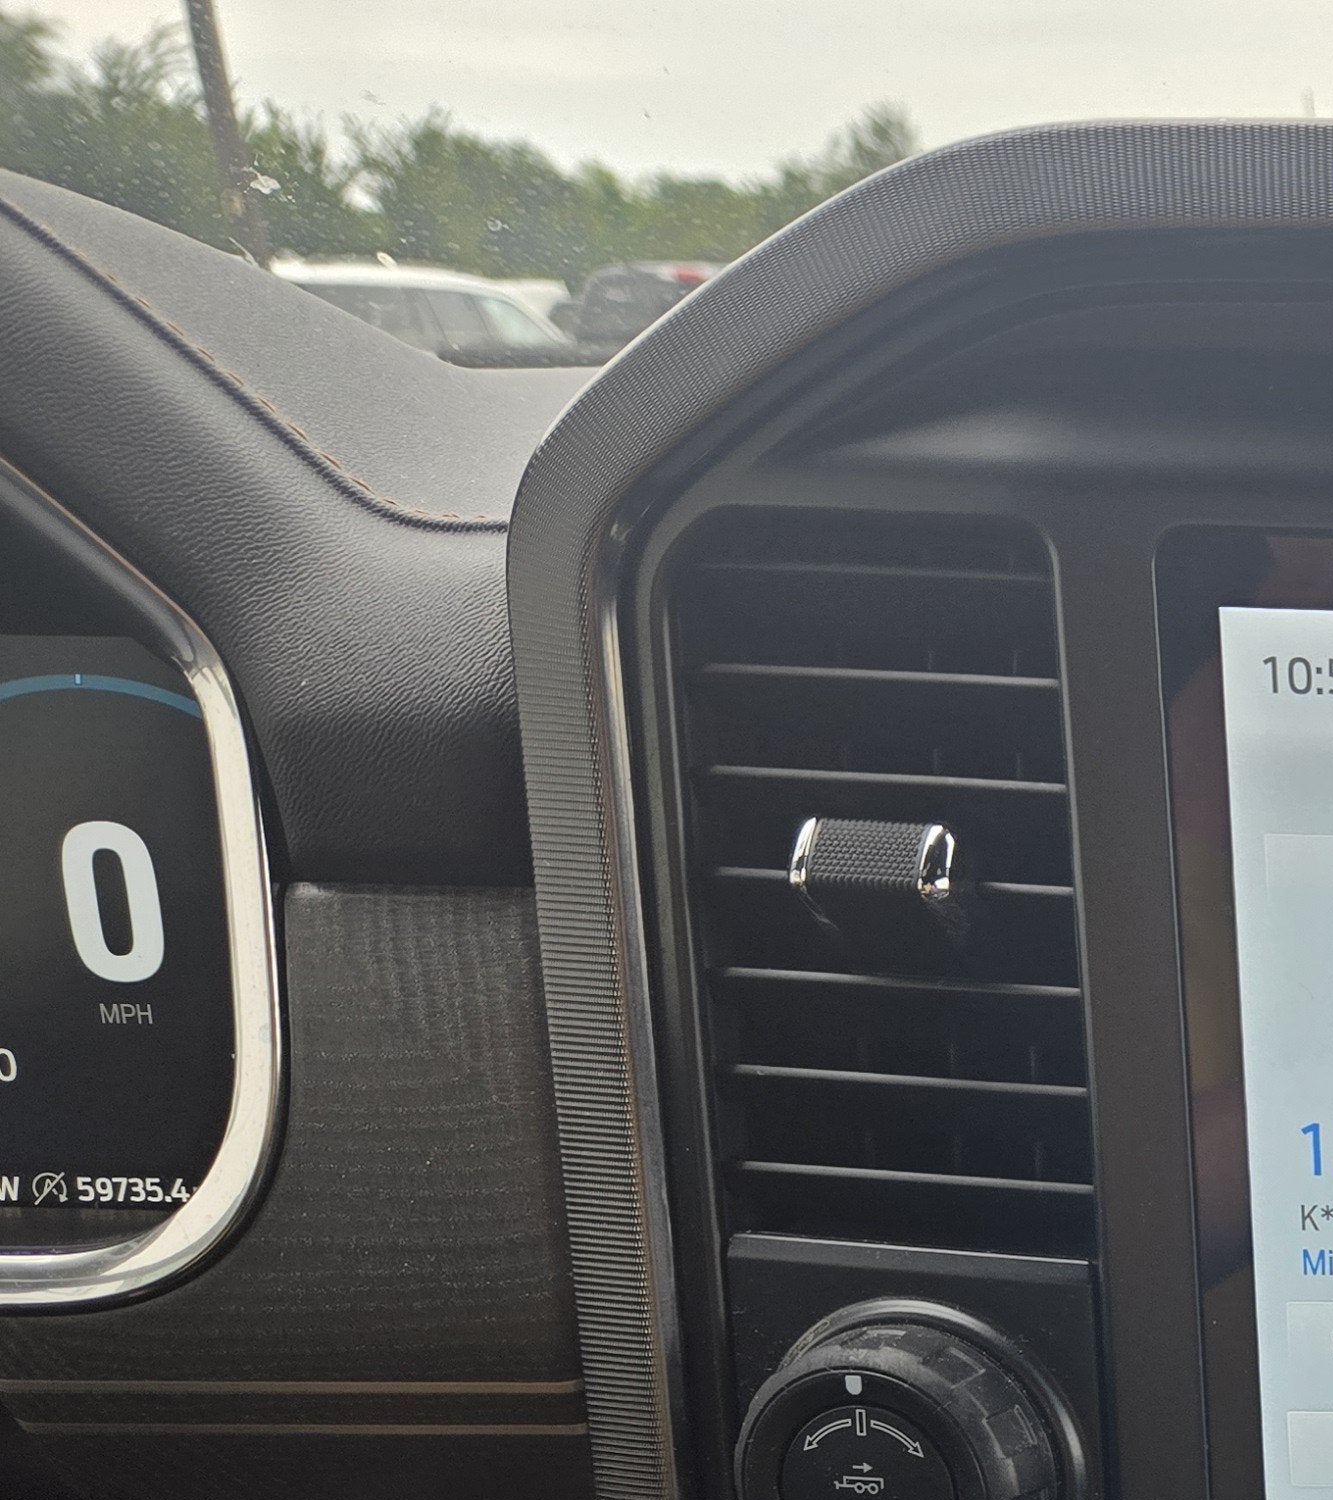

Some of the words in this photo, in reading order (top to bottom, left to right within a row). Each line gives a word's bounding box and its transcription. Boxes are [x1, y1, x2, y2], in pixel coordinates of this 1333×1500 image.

[61, 820, 165, 983] 0
[100, 1003, 153, 1025] MPH
[77, 1177, 191, 1203] 59735.4
